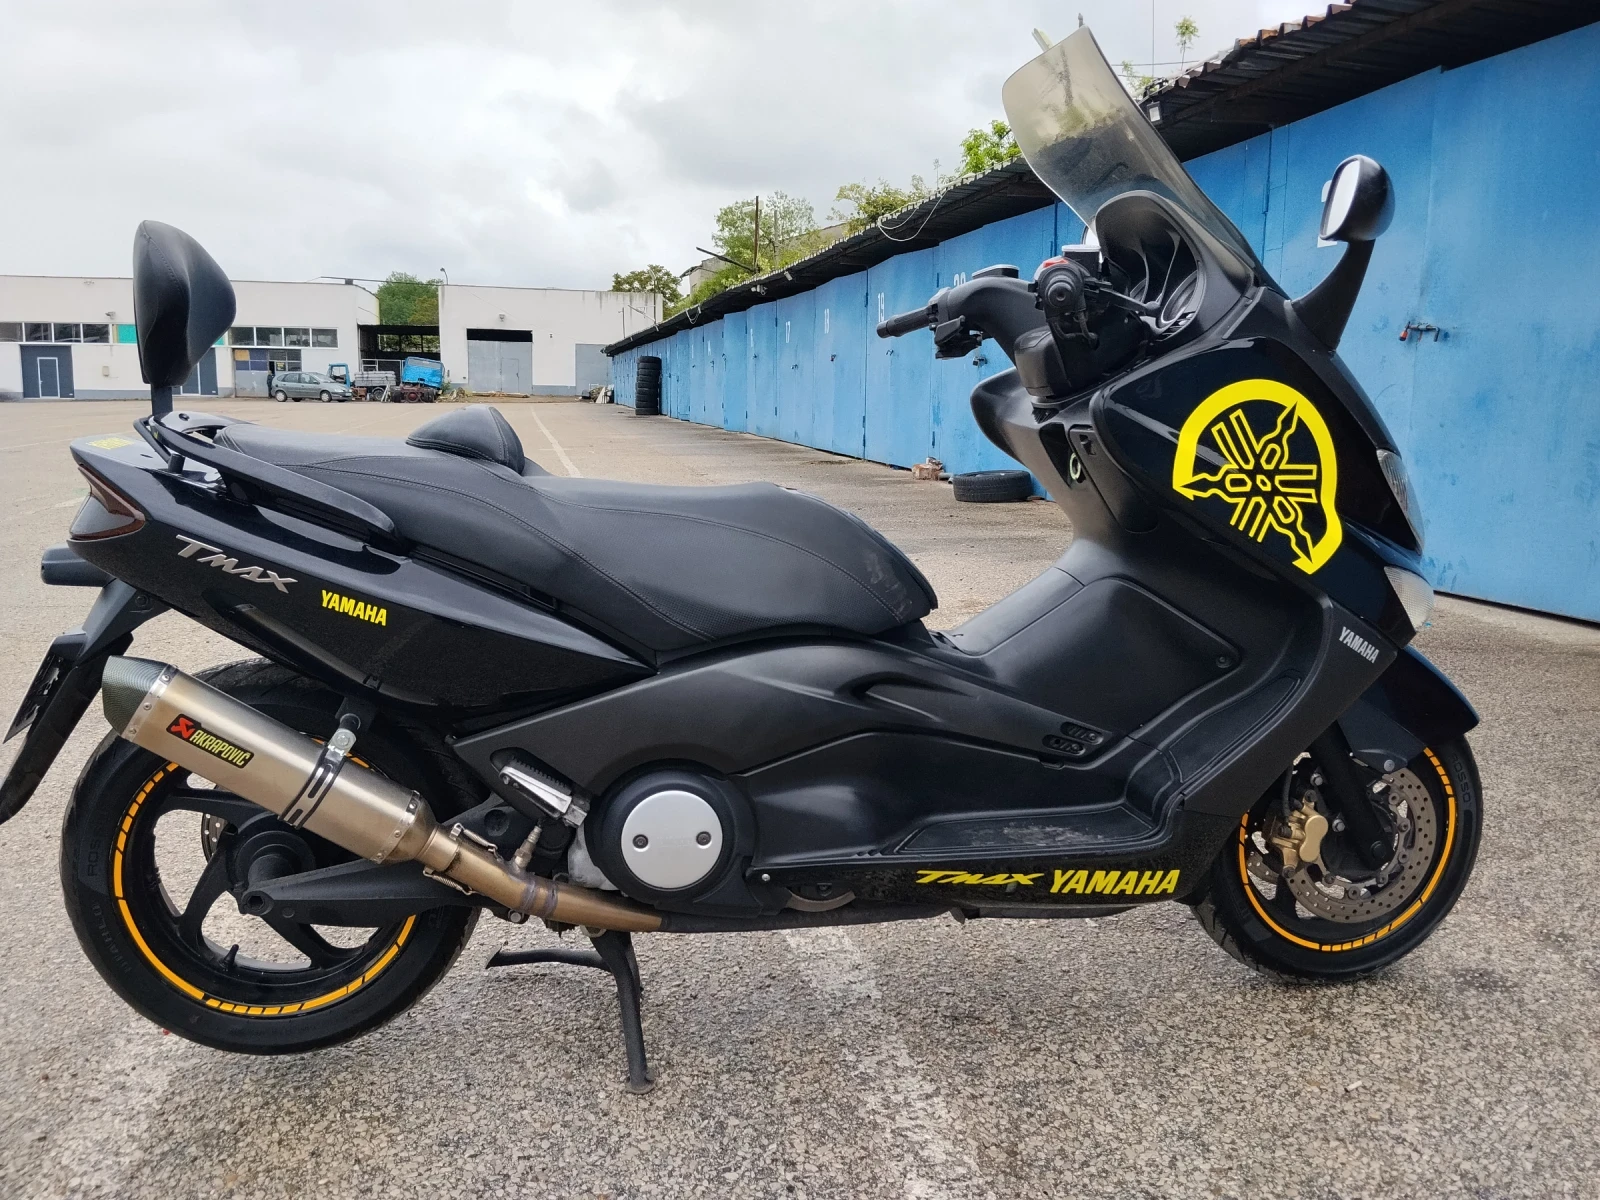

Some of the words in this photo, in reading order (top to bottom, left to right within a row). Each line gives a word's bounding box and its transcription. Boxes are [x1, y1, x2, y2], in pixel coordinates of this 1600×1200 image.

[877, 292, 885, 323] 19
[175, 534, 298, 593] TMAX
[321, 590, 387, 626] YAMAHA
[1339, 626, 1380, 664] YAMAHA
[916, 870, 1045, 885] TMAX
[1050, 869, 1180, 894] YAMAHA
